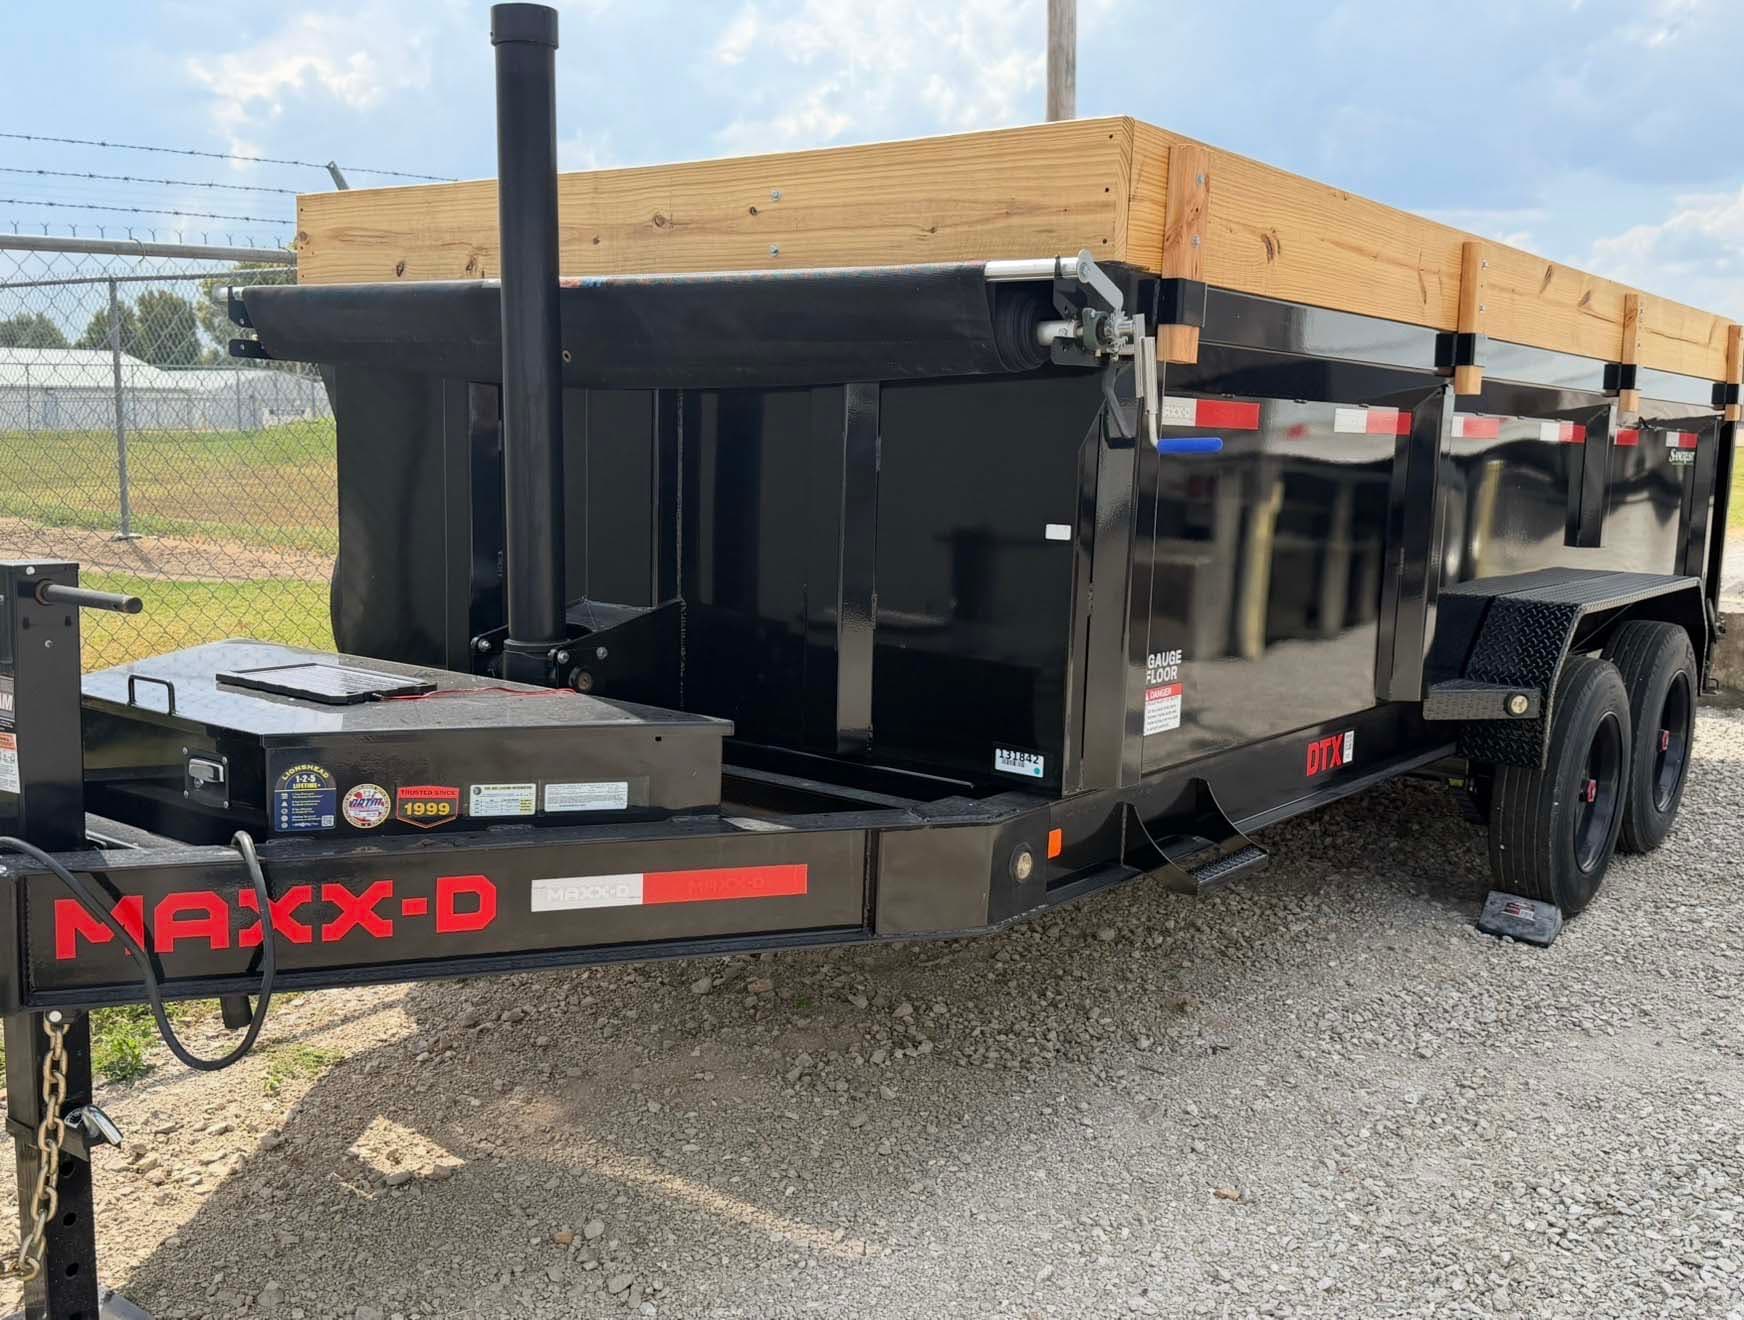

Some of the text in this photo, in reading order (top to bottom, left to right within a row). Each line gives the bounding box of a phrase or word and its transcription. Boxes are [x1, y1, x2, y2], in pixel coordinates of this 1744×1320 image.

[1147, 649, 1183, 669] GAUGE
[1145, 665, 1178, 684] FLOOR
[999, 750, 1039, 764] 131842
[1307, 733, 1343, 776] DTX
[281, 763, 330, 781] LIONSHEAD
[295, 775, 316, 783] 1-2-5
[404, 802, 450, 816] 1999
[547, 884, 630, 901] MAXX-D
[54, 874, 497, 960] MAXX-D
